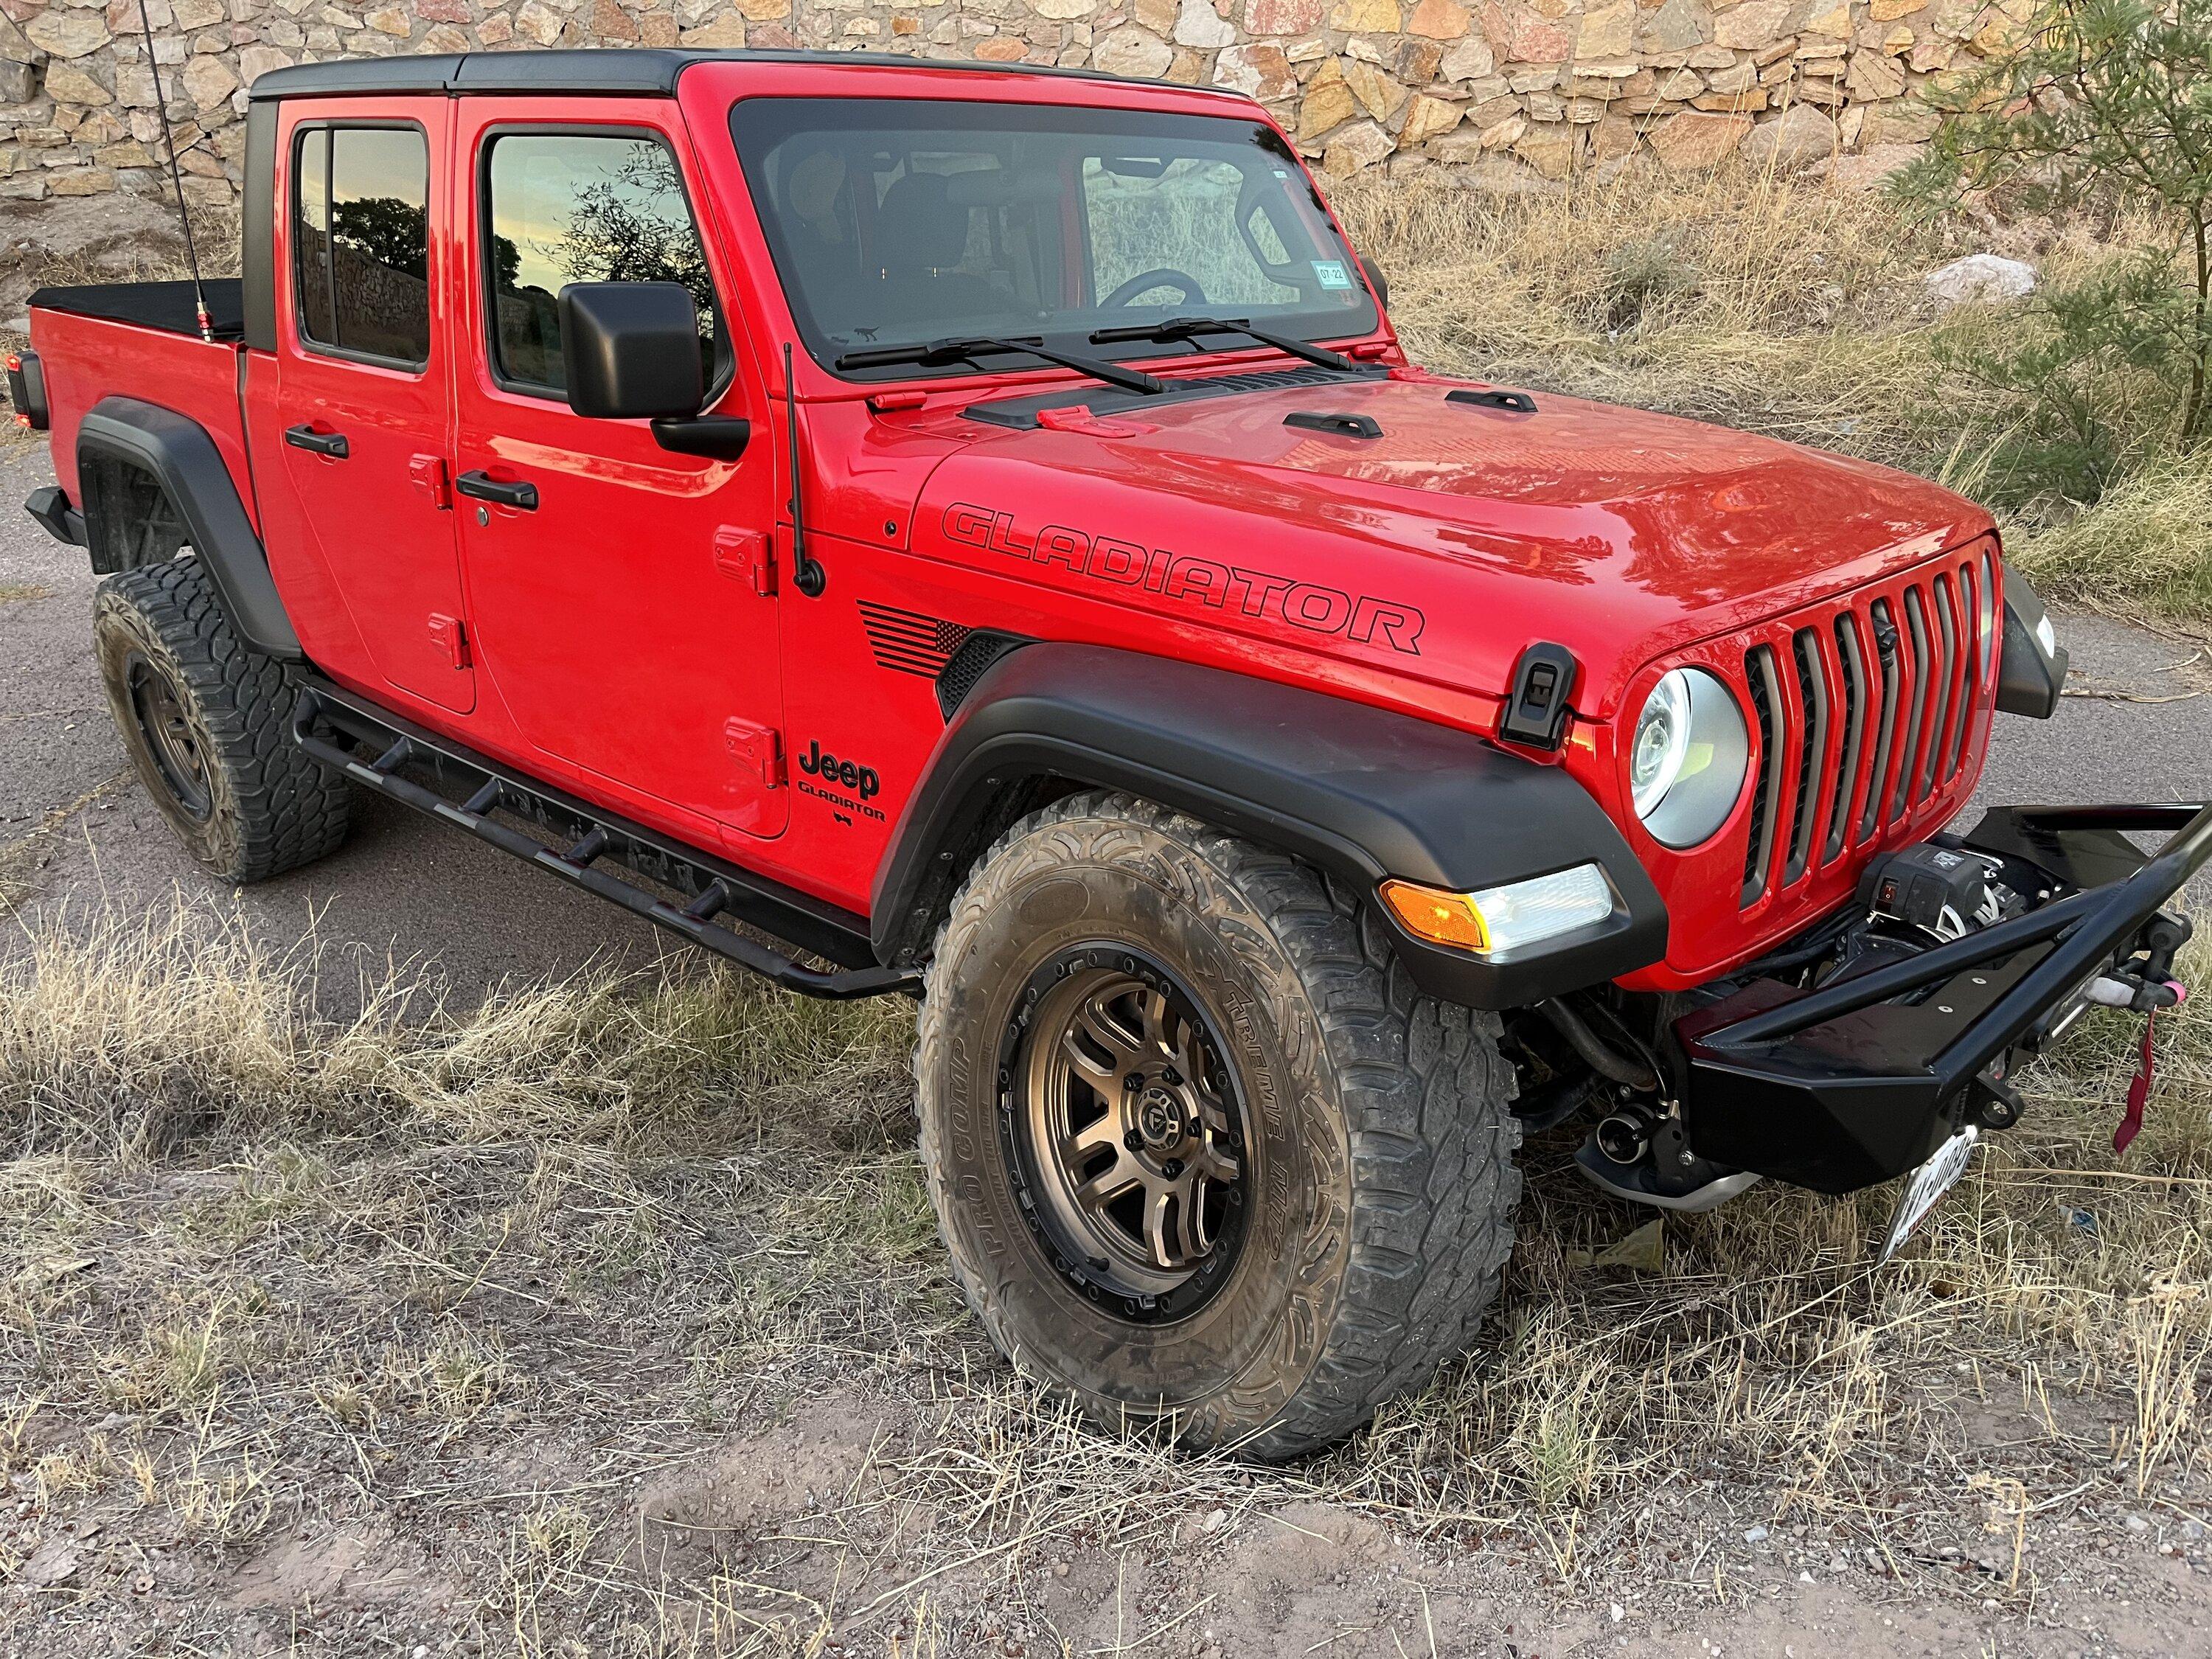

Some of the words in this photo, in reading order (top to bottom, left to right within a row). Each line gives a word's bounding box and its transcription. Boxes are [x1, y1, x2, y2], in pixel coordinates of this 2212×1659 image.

[942, 502, 1425, 655] GLADIATOR
[798, 738, 880, 801] Jeep
[798, 780, 886, 823] GLADIATOR
[950, 1037, 975, 1161] COMP
[1195, 955, 1284, 1141] XTREME
[1265, 1160, 1289, 1261] MT2
[961, 1175, 1007, 1256] PRO
